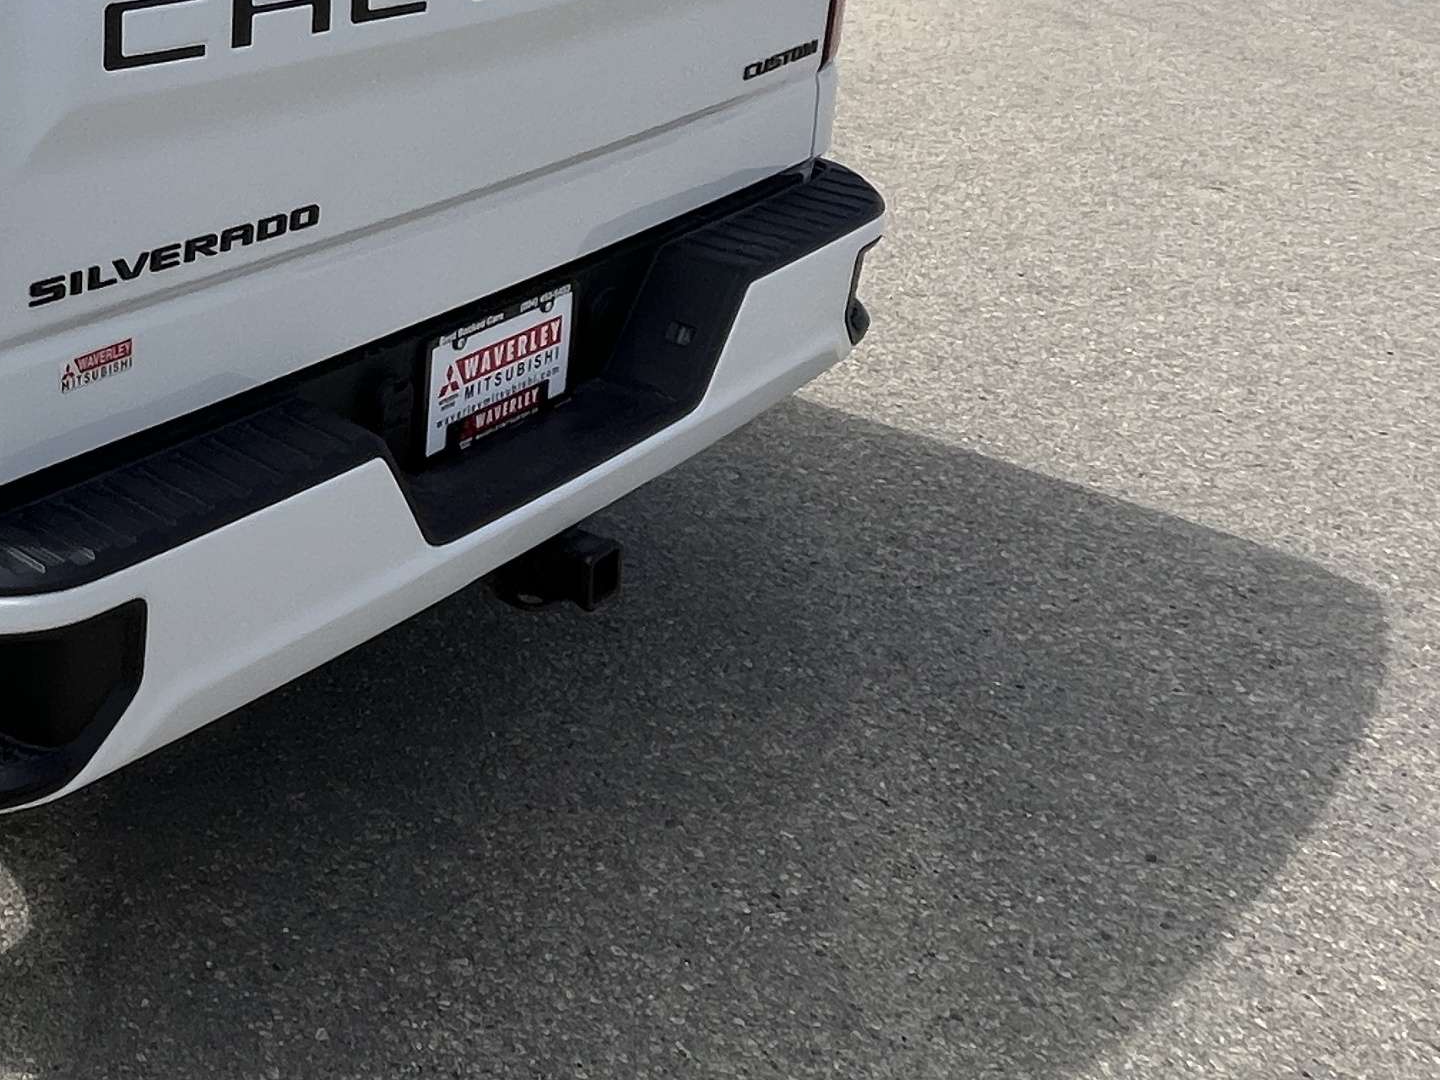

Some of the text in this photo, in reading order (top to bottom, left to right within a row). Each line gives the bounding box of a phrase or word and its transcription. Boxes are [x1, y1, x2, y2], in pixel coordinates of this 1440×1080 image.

[742, 39, 818, 81] CUSTOM
[28, 203, 321, 308] SILVERADO
[78, 341, 131, 372] WAVERLEY
[464, 318, 561, 380] WAVERLEY
[61, 357, 132, 394] MITSUBISHI
[464, 347, 559, 400] MITSUBISHI
[475, 386, 540, 429] WAVERLEY
